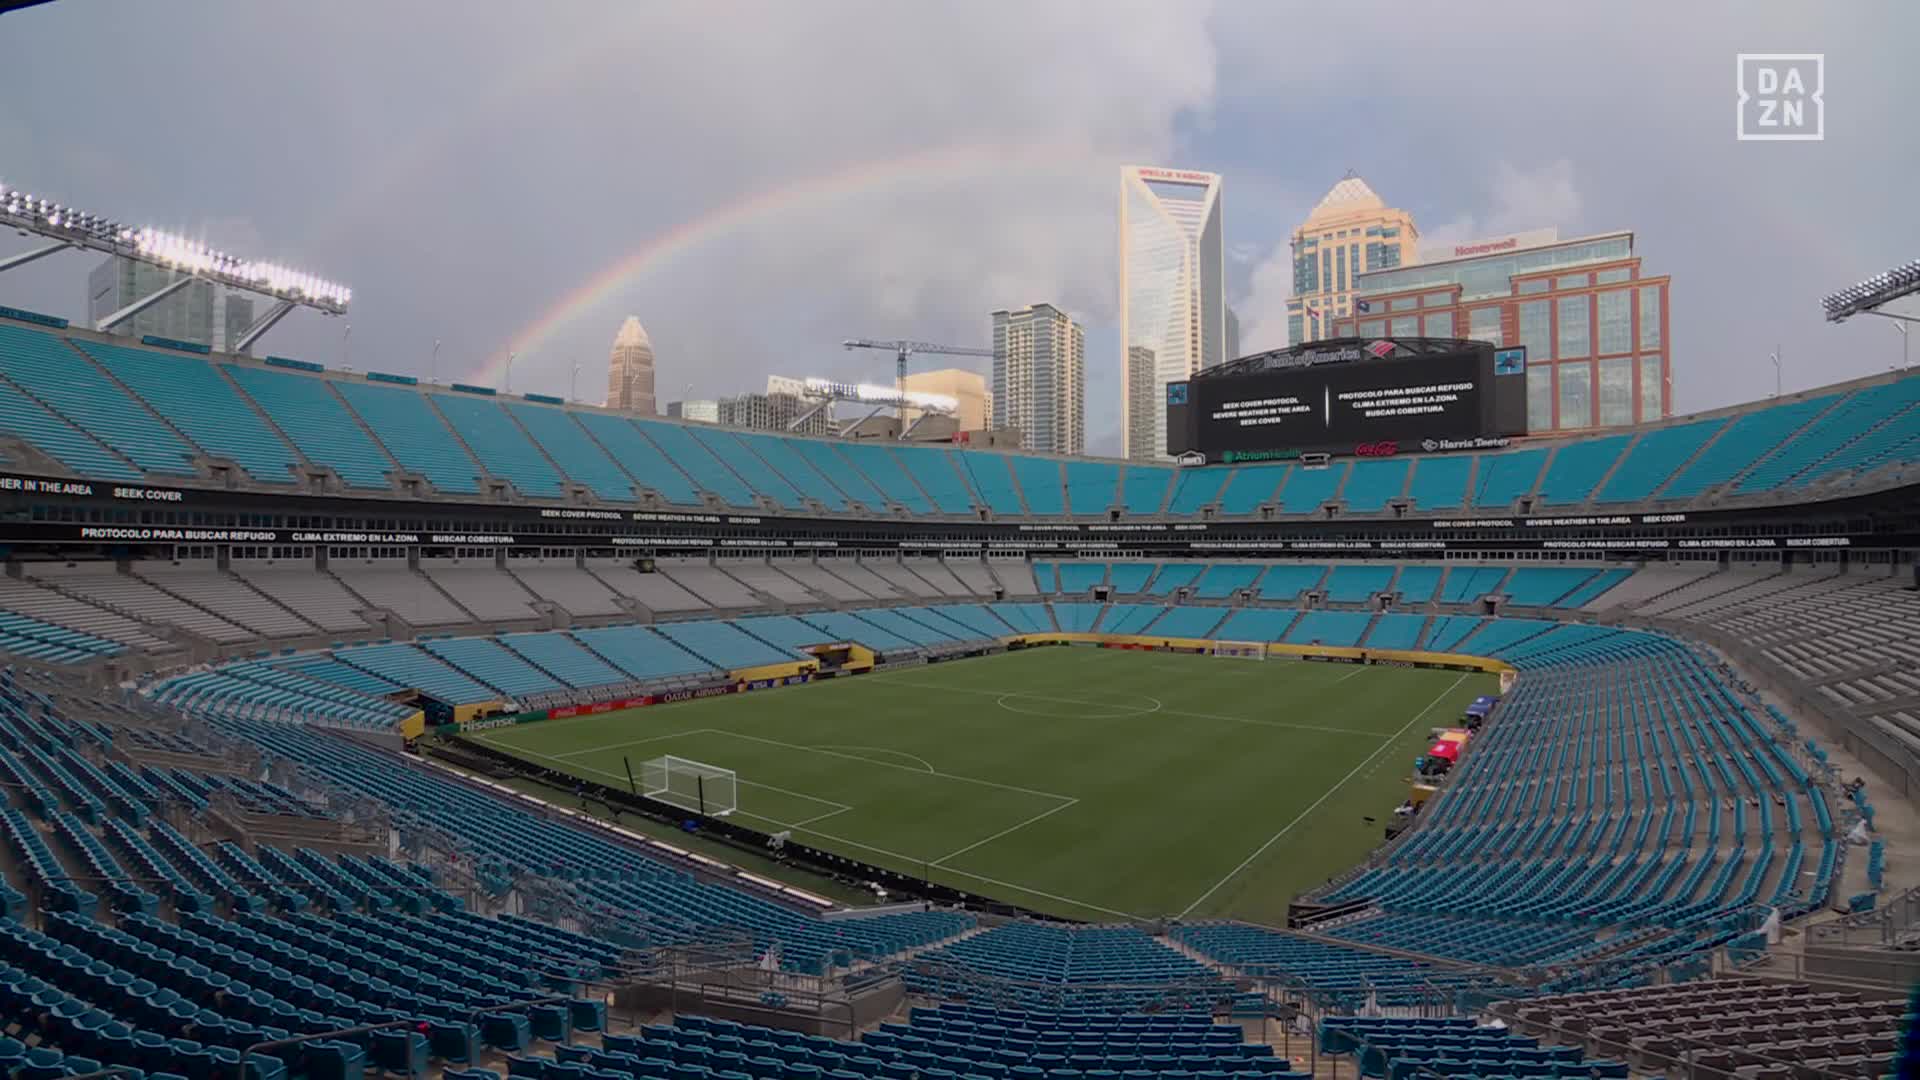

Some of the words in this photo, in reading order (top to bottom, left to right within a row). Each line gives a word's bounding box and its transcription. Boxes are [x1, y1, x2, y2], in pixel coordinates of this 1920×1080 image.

[1339, 391, 1383, 400] PROTOCOLO
[1384, 388, 1404, 396] PARA
[1405, 386, 1437, 394] BUSCAR
[1438, 382, 1473, 391] REFUGIO
[1263, 397, 1299, 405] PROTOCOL
[1376, 398, 1411, 406] EXTREMO
[1365, 408, 1396, 417] BUSCAR
[1397, 405, 1444, 414] COBERTURA
[1440, 439, 1473, 449] Harris
[24, 480, 37, 491] IN
[39, 481, 61, 493] THE
[63, 483, 92, 495] AREA
[114, 487, 144, 499] SEEK
[146, 490, 182, 501] COVER
[561, 510, 585, 518] COVER
[586, 511, 622, 519] PROTOCOL
[1643, 515, 1660, 523] SEEK
[1661, 514, 1685, 522] COVER
[81, 528, 151, 539] PROTOCOLO
[153, 529, 184, 539] PARA
[185, 530, 228, 540] BUSCAR
[230, 531, 276, 541] REFUGIO
[291, 532, 321, 541] CLIMA
[323, 533, 367, 541] EXTREMO
[368, 533, 381, 542] EN
[382, 533, 394, 542] LA
[395, 534, 418, 542] ZONA
[432, 534, 466, 543] BUSCAR
[468, 535, 514, 543] COBERTURA
[664, 690, 691, 703] QATAR
[694, 686, 727, 697] AIRWAYS
[460, 716, 516, 732] Hisense
